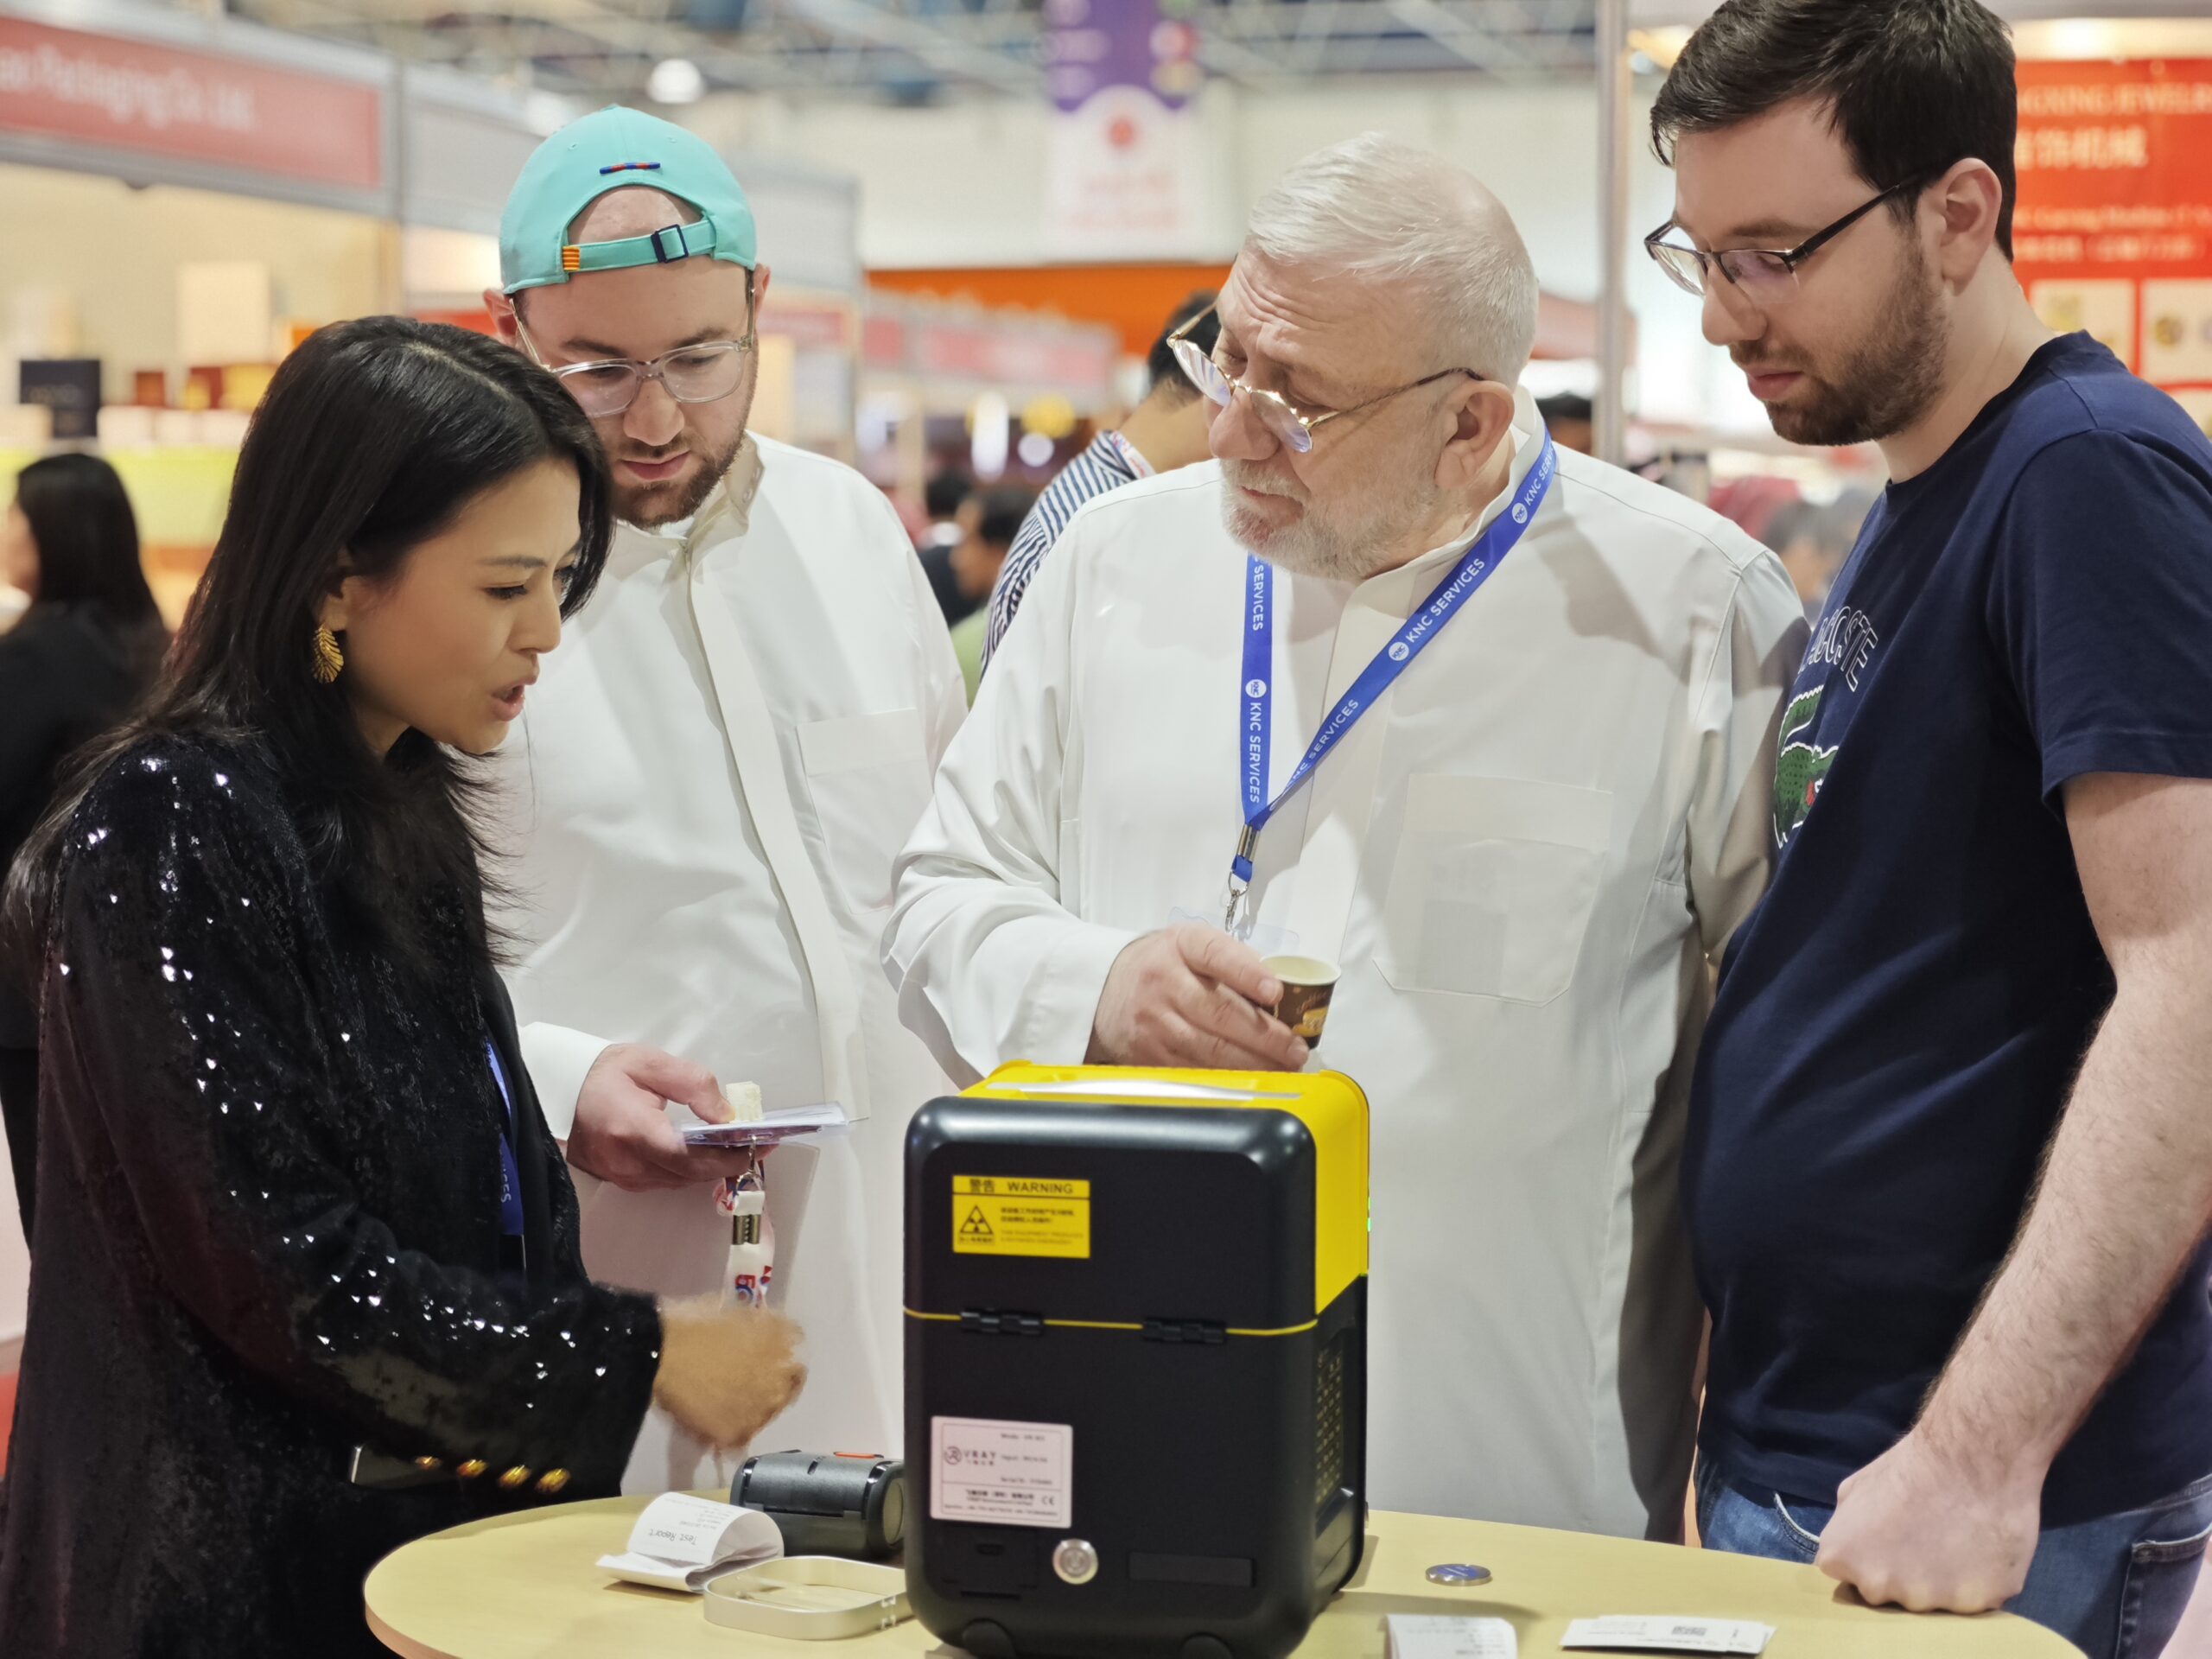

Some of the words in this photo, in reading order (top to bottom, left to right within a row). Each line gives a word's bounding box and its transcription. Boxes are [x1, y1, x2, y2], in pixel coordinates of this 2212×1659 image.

[1524, 478, 1541, 506] KNC
[1252, 564, 1264, 632] SERVICES
[1405, 614, 1433, 643] KNC
[1430, 558, 1485, 616] SERVICES
[1249, 702, 1262, 731] KNC
[1308, 699, 1360, 760] SERVICES
[1249, 735, 1262, 804] SERVICES
[969, 1178, 995, 1193] 警告
[1007, 1181, 1074, 1195] WARNING
[648, 1529, 677, 1542] Report
[679, 1533, 697, 1546] Test
